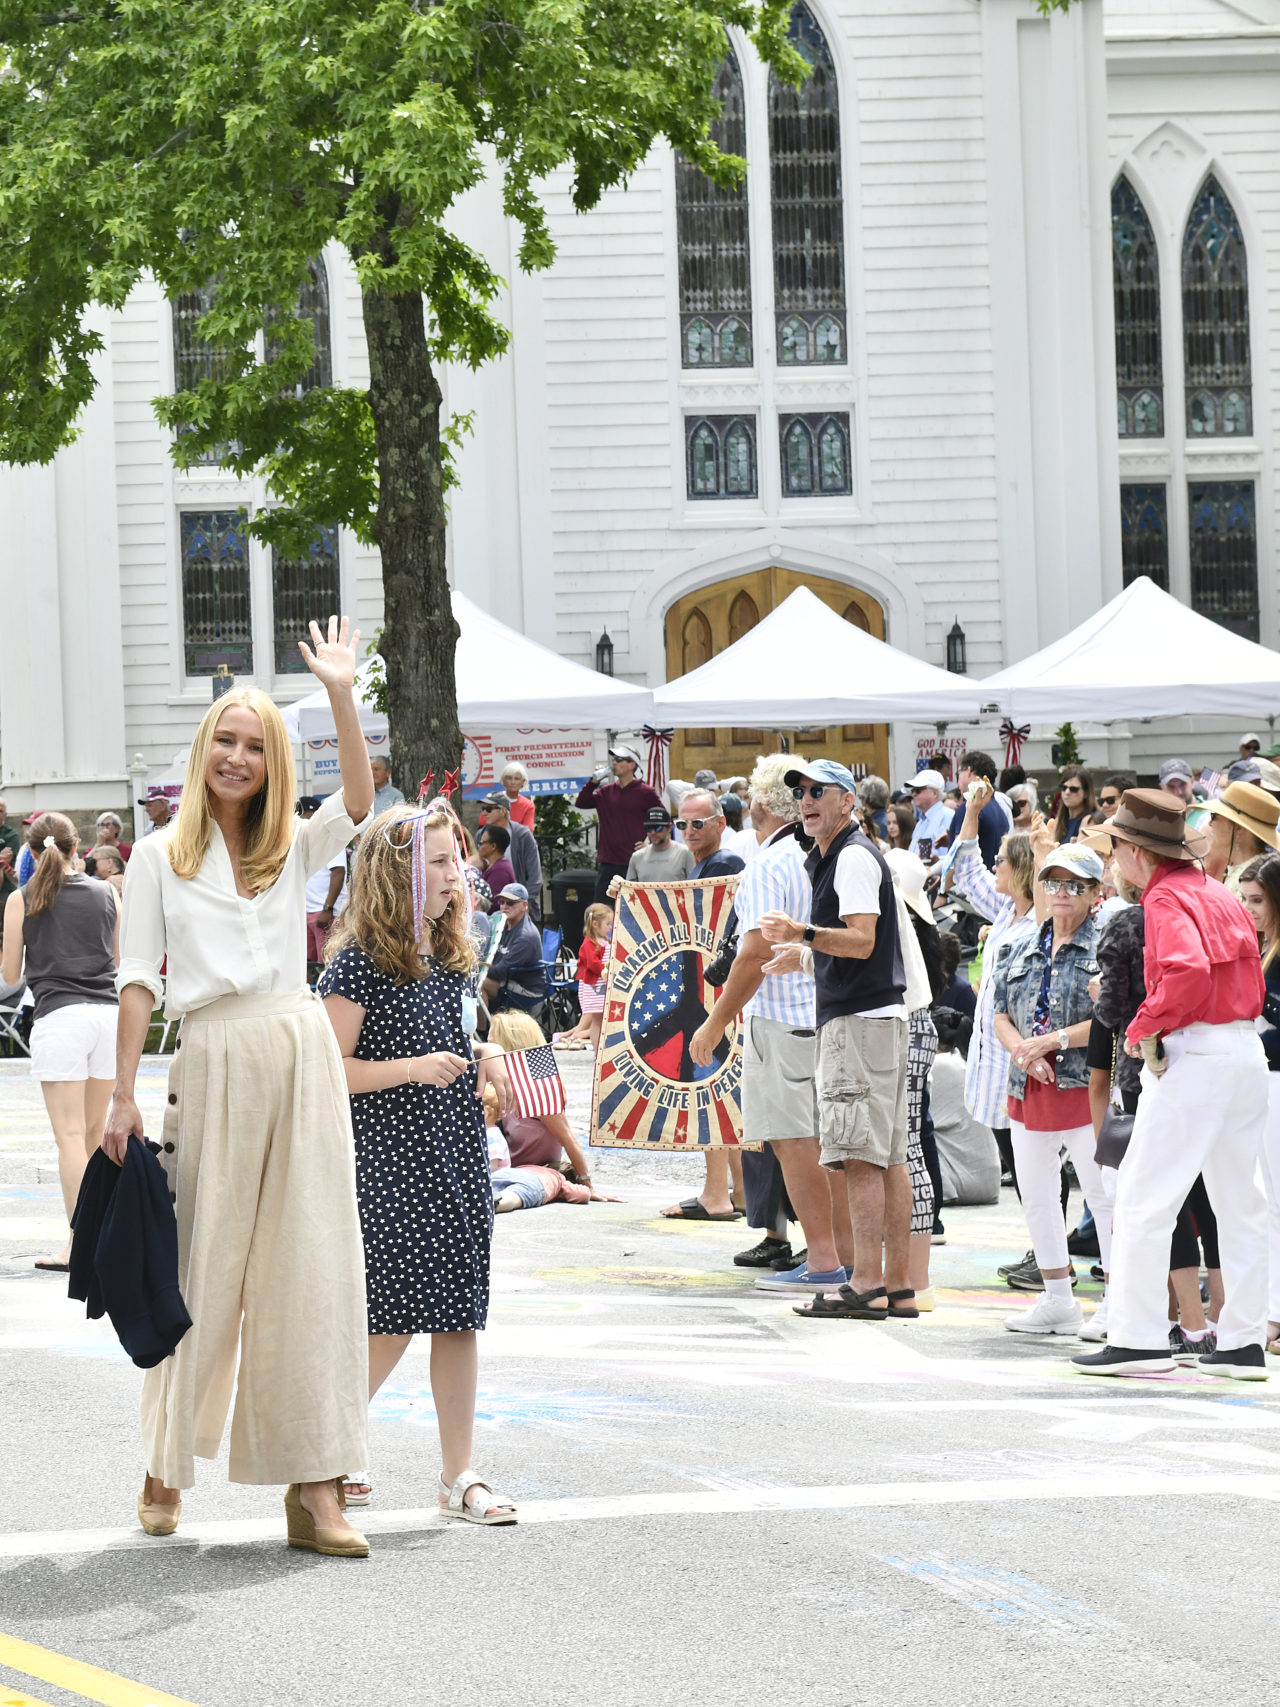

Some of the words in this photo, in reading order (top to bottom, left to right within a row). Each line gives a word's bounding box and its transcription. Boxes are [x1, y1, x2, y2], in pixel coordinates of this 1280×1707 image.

[495, 745, 521, 753] FIRST
[524, 741, 593, 752] PRESBYTERIAN
[917, 739, 935, 748] GOD
[939, 738, 967, 748] BLESS
[505, 753, 543, 761] CHURCH
[545, 750, 585, 759] MISSION
[315, 759, 338, 769] BUY
[526, 760, 566, 769] COUNCIL
[314, 768, 341, 777] SUPPO
[521, 780, 578, 793] MERICA
[614, 931, 667, 988] IMAGINE
[669, 924, 689, 944] ALL
[694, 924, 713, 949] THE
[614, 1052, 656, 1098] LIVING
[658, 1088, 690, 1109] LIFE
[696, 1088, 710, 1108] IN
